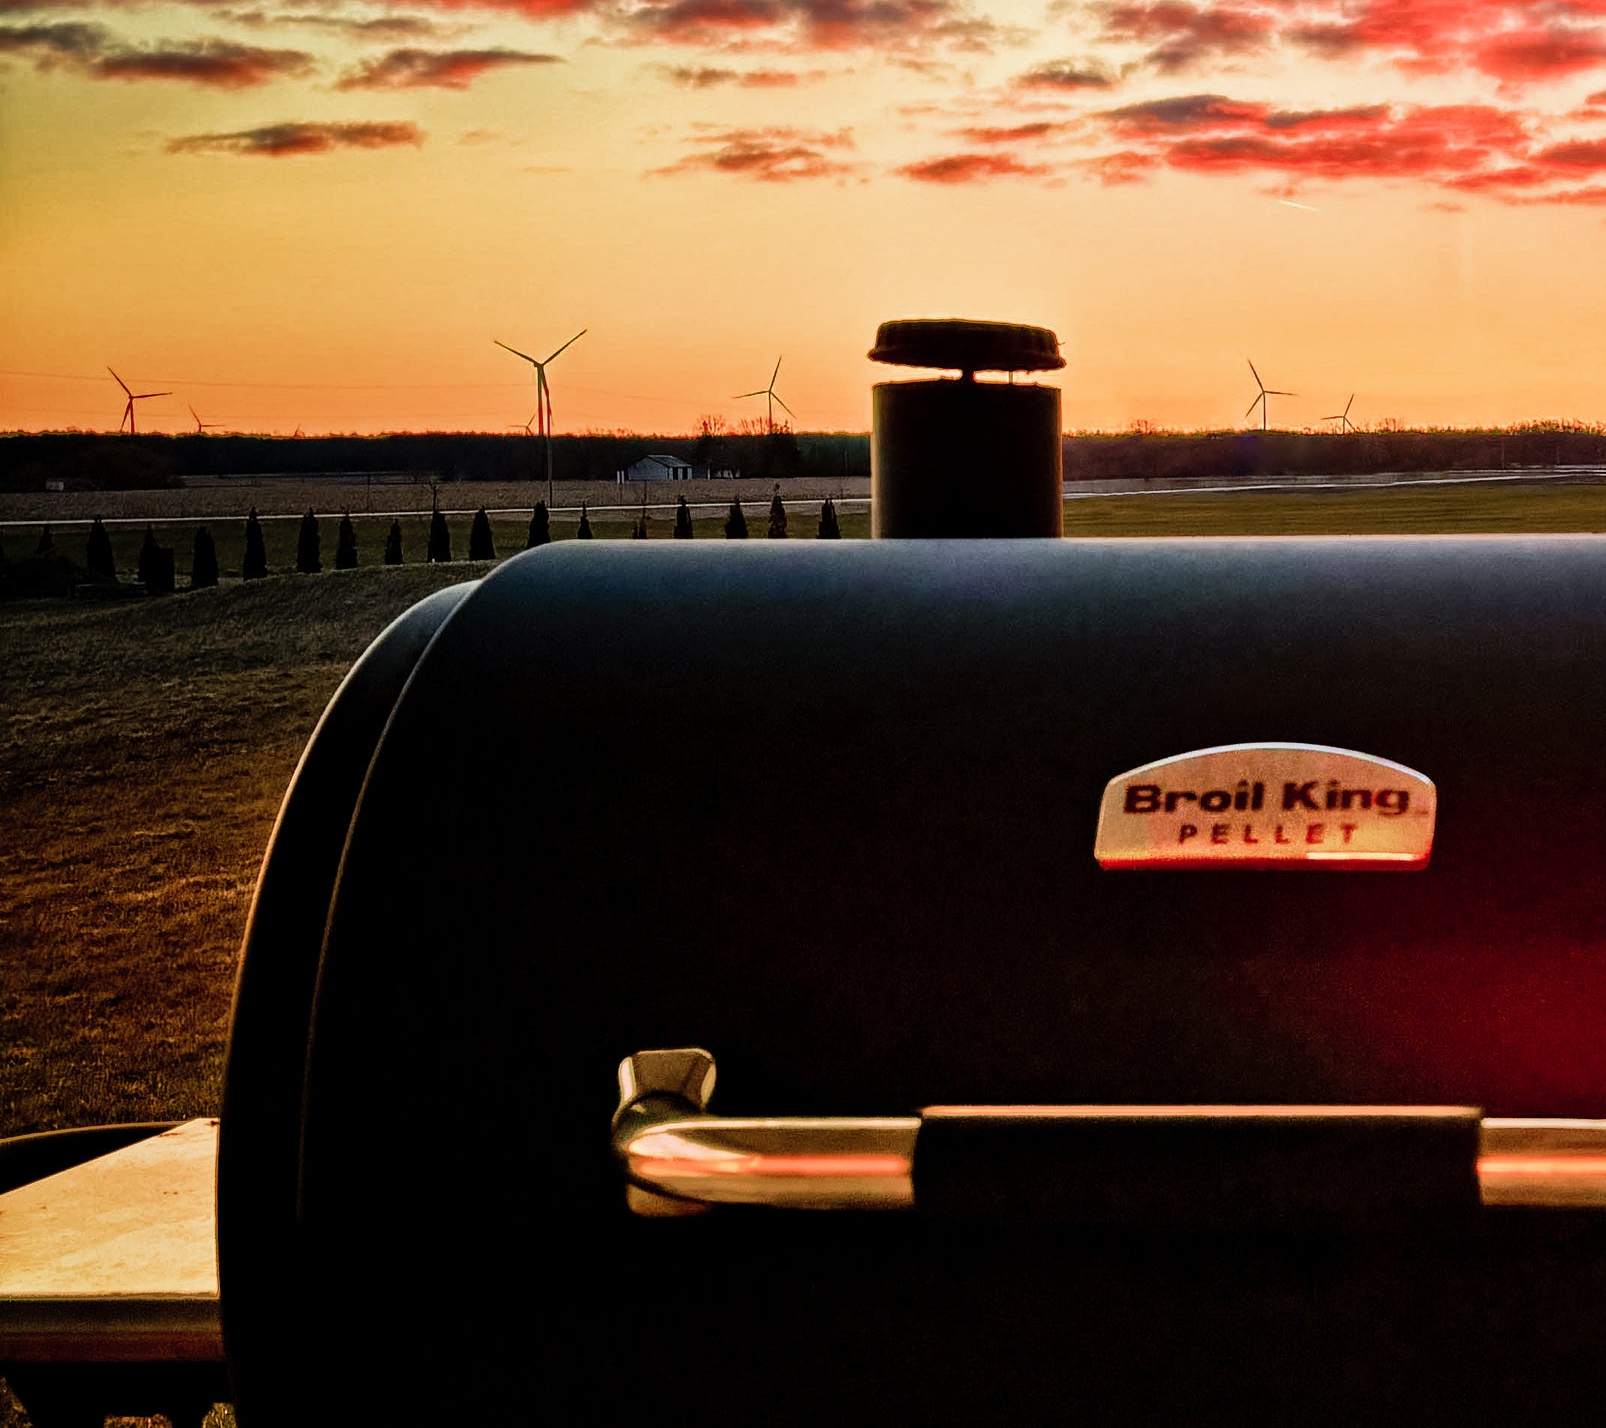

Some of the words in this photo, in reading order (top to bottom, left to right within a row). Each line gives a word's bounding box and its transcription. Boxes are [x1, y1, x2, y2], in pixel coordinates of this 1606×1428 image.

[1123, 780, 1264, 814] Broil
[1281, 780, 1411, 818] King
[1179, 824, 1359, 844] PELLET
